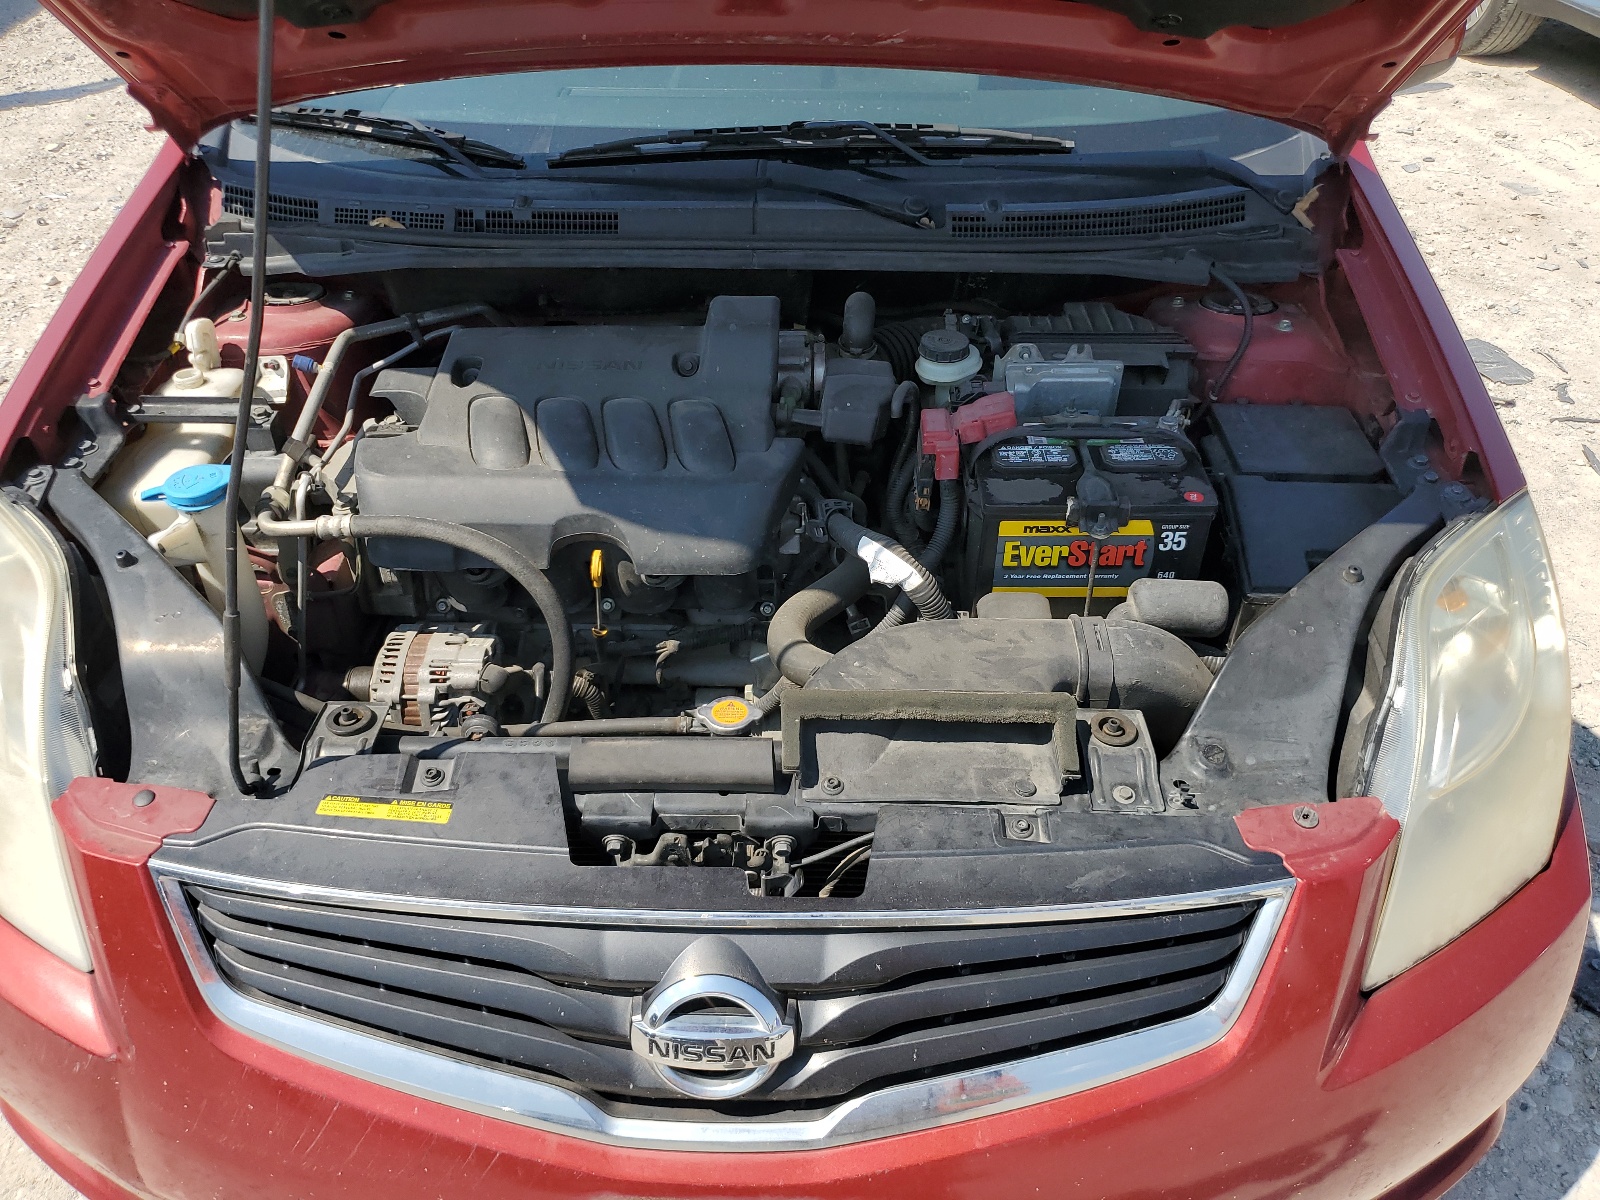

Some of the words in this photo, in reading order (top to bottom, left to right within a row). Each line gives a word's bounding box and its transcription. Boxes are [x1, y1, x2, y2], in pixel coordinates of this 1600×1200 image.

[536, 359, 644, 371] NISSAN
[1158, 531, 1188, 551] 35
[1002, 539, 1148, 568] EverStart
[1157, 571, 1176, 579] 640
[648, 1038, 776, 1064] NISSAN
